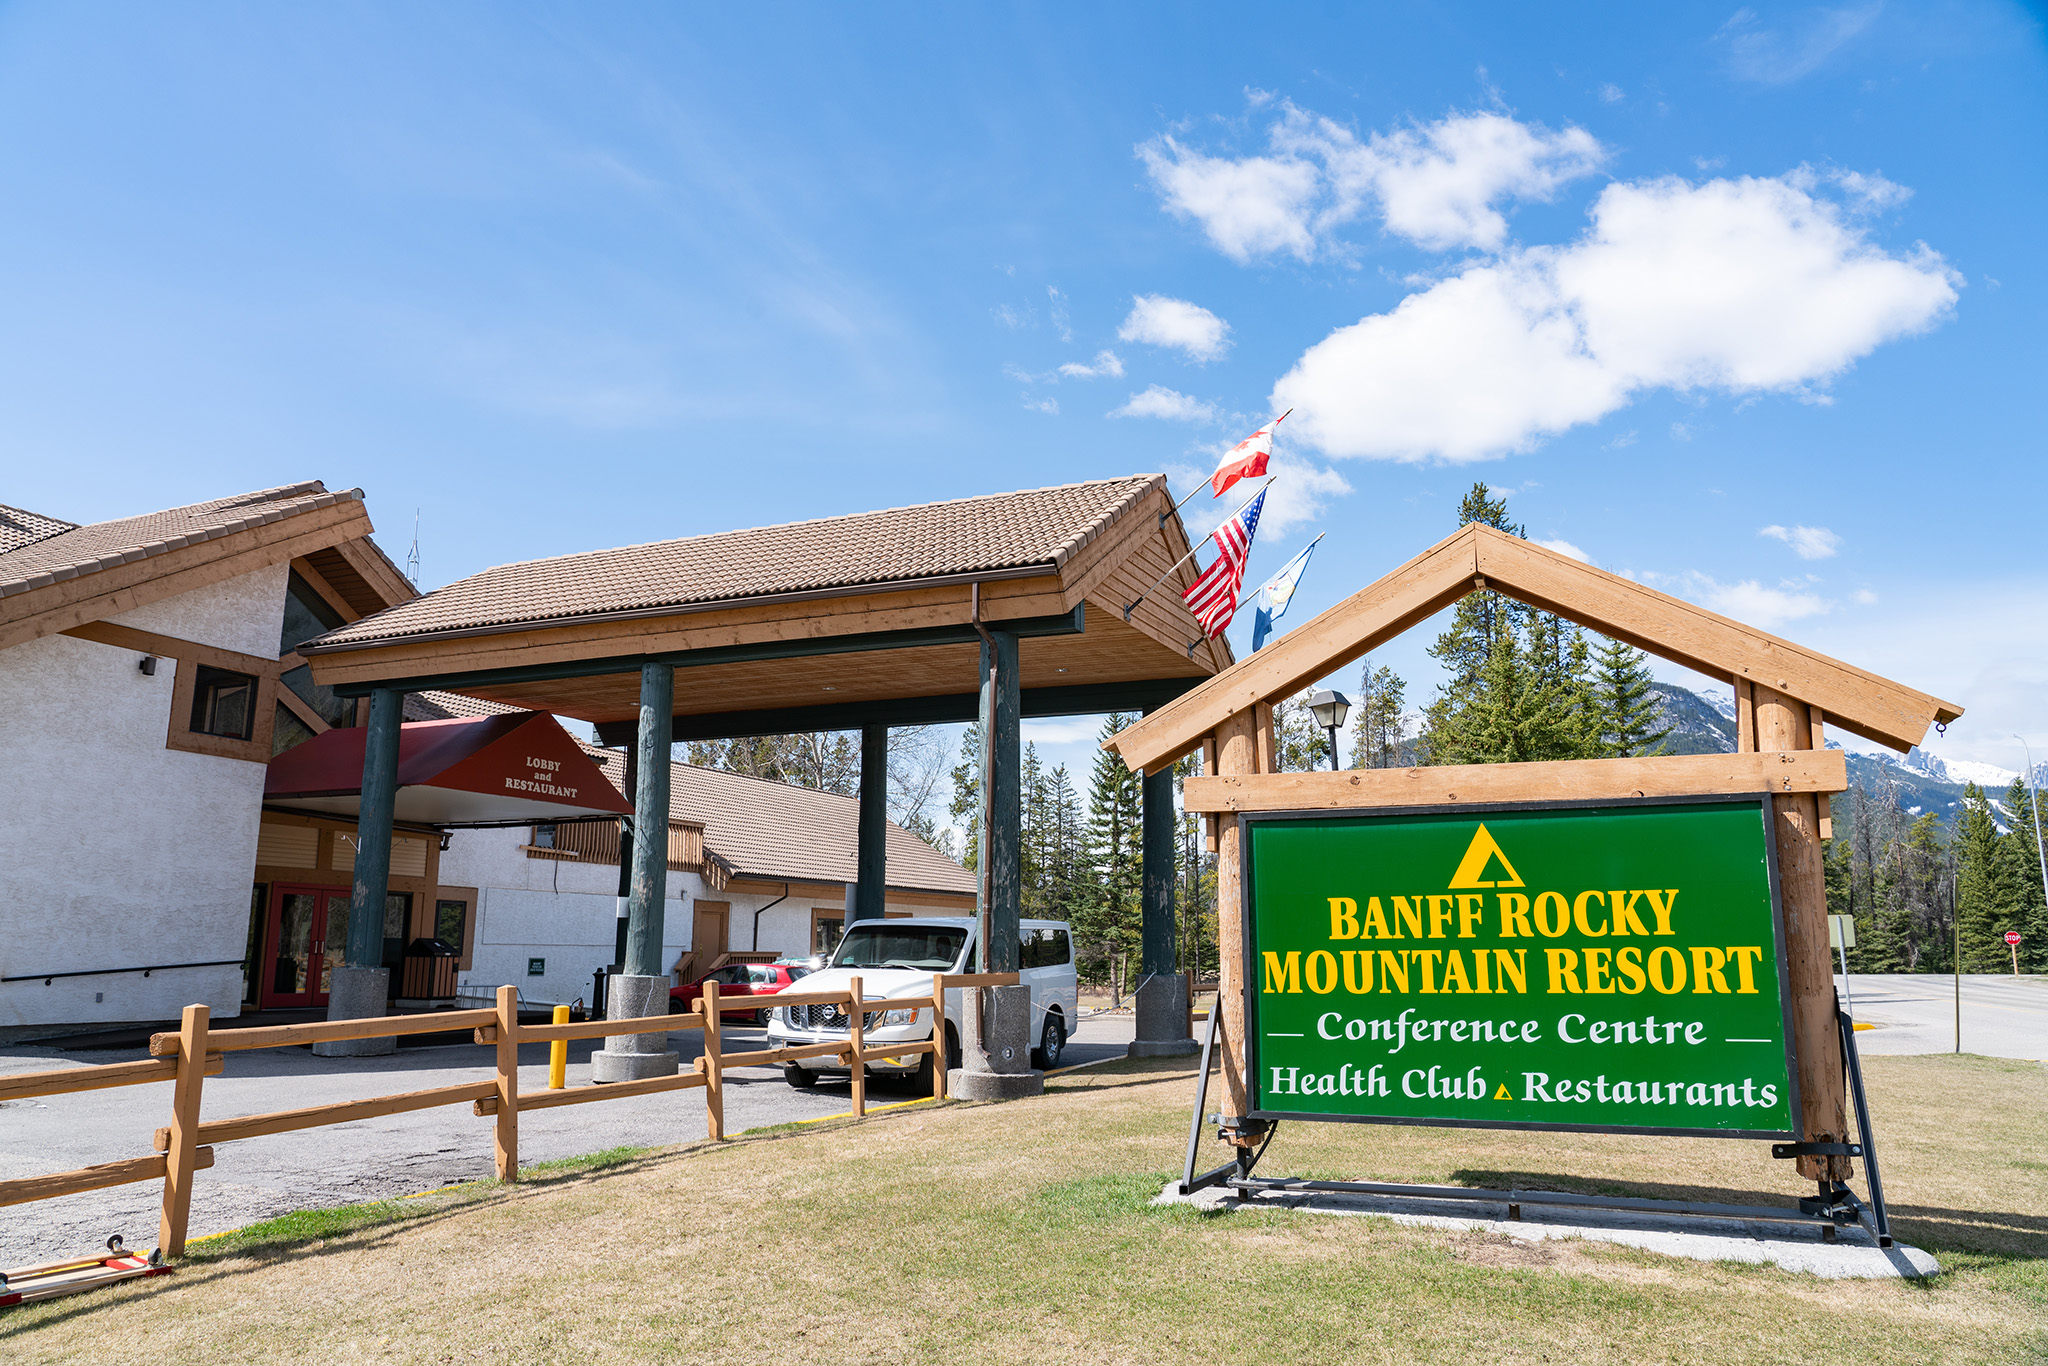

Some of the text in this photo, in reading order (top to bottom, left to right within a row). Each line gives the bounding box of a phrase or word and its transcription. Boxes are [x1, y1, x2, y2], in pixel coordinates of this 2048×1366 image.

[526, 756, 561, 772] LOBBY
[534, 772, 552, 782] and
[505, 777, 578, 798] RESTAURANT
[1327, 889, 1679, 940] BANFF ROCKY
[1262, 946, 1762, 995] MOUNTAIN RESORT
[1317, 1008, 1707, 1054] Conference Centre
[1269, 1063, 1778, 1109] Health Club Restaurants
